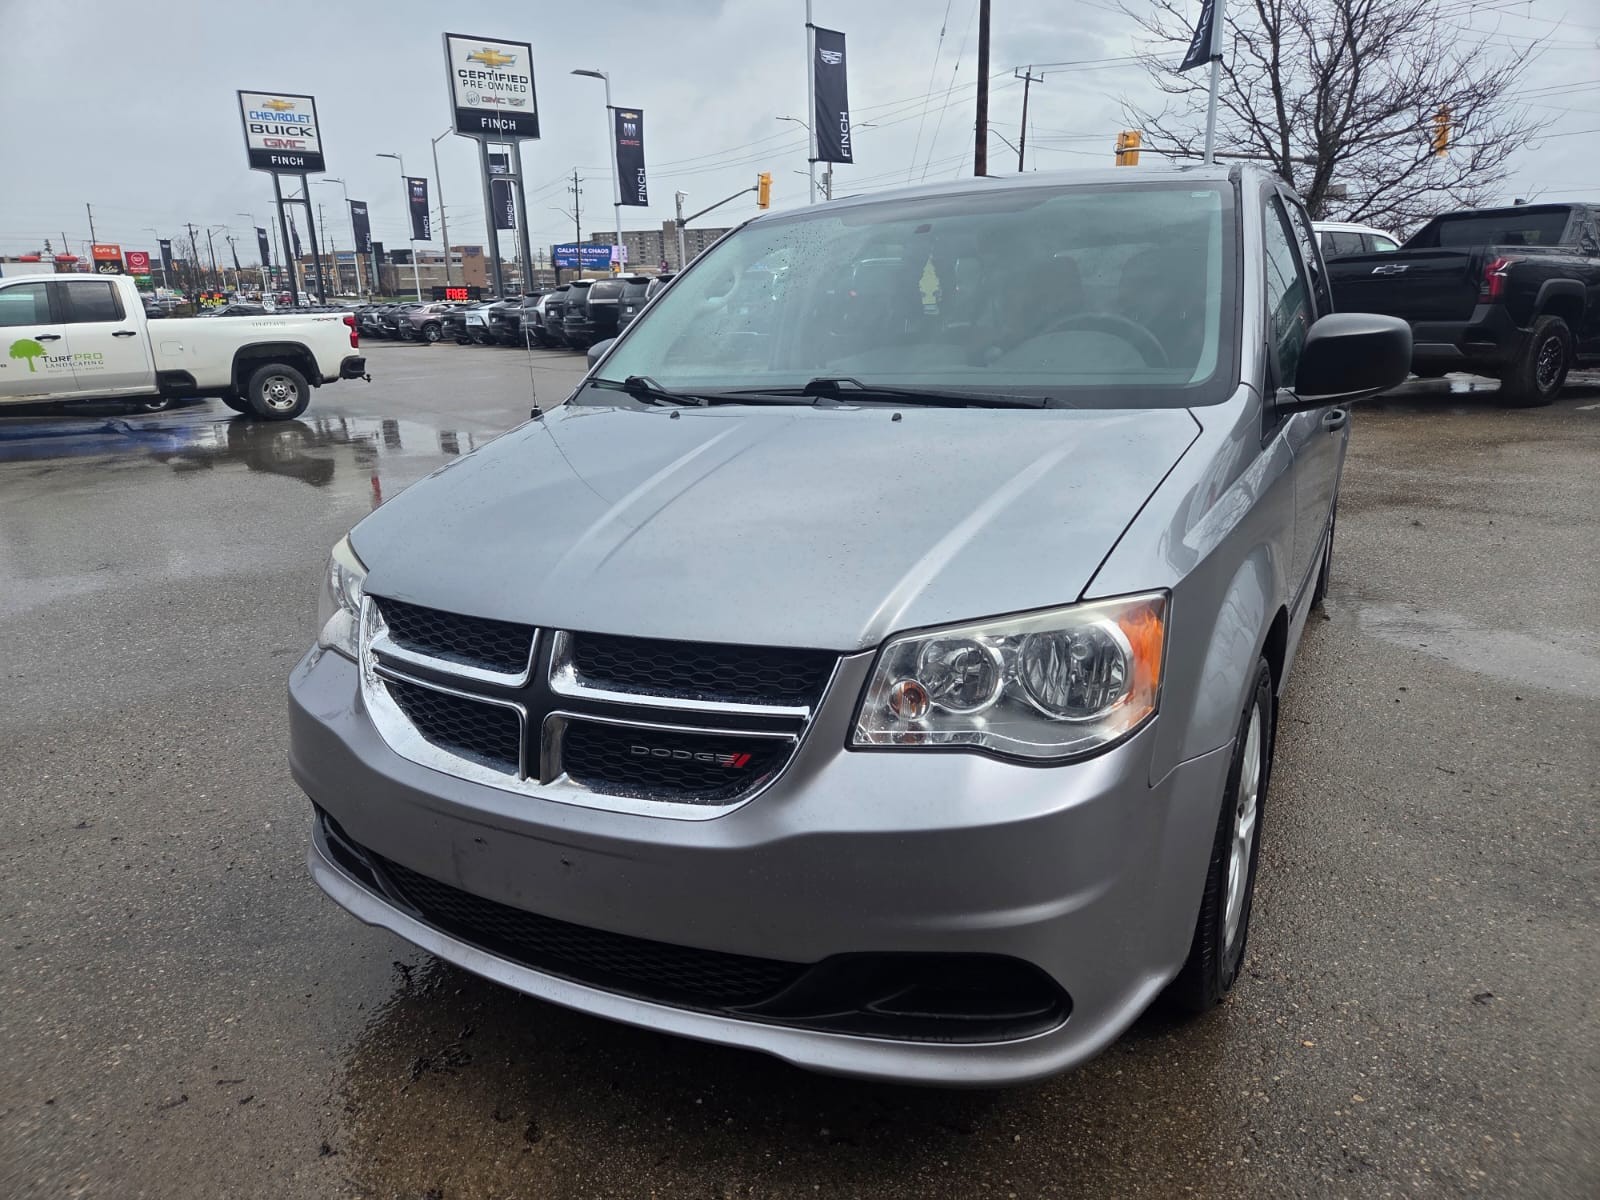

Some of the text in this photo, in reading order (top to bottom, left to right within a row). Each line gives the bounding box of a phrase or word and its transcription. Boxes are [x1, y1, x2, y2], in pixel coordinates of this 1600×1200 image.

[458, 69, 528, 84] CERTIFIED
[462, 79, 526, 93] PRE-OWNED
[481, 96, 506, 104] GMC
[249, 110, 311, 124] CHEVROLET
[481, 117, 516, 130] FINCH
[249, 123, 314, 138] BUICK
[840, 111, 851, 157] FINCH
[263, 137, 306, 150] GMC
[271, 155, 304, 166] FINCH
[637, 168, 646, 202] FINCH
[446, 288, 468, 299] FREE
[46, 360, 104, 368] LANDSCAPING
[630, 745, 736, 763] DODGE
